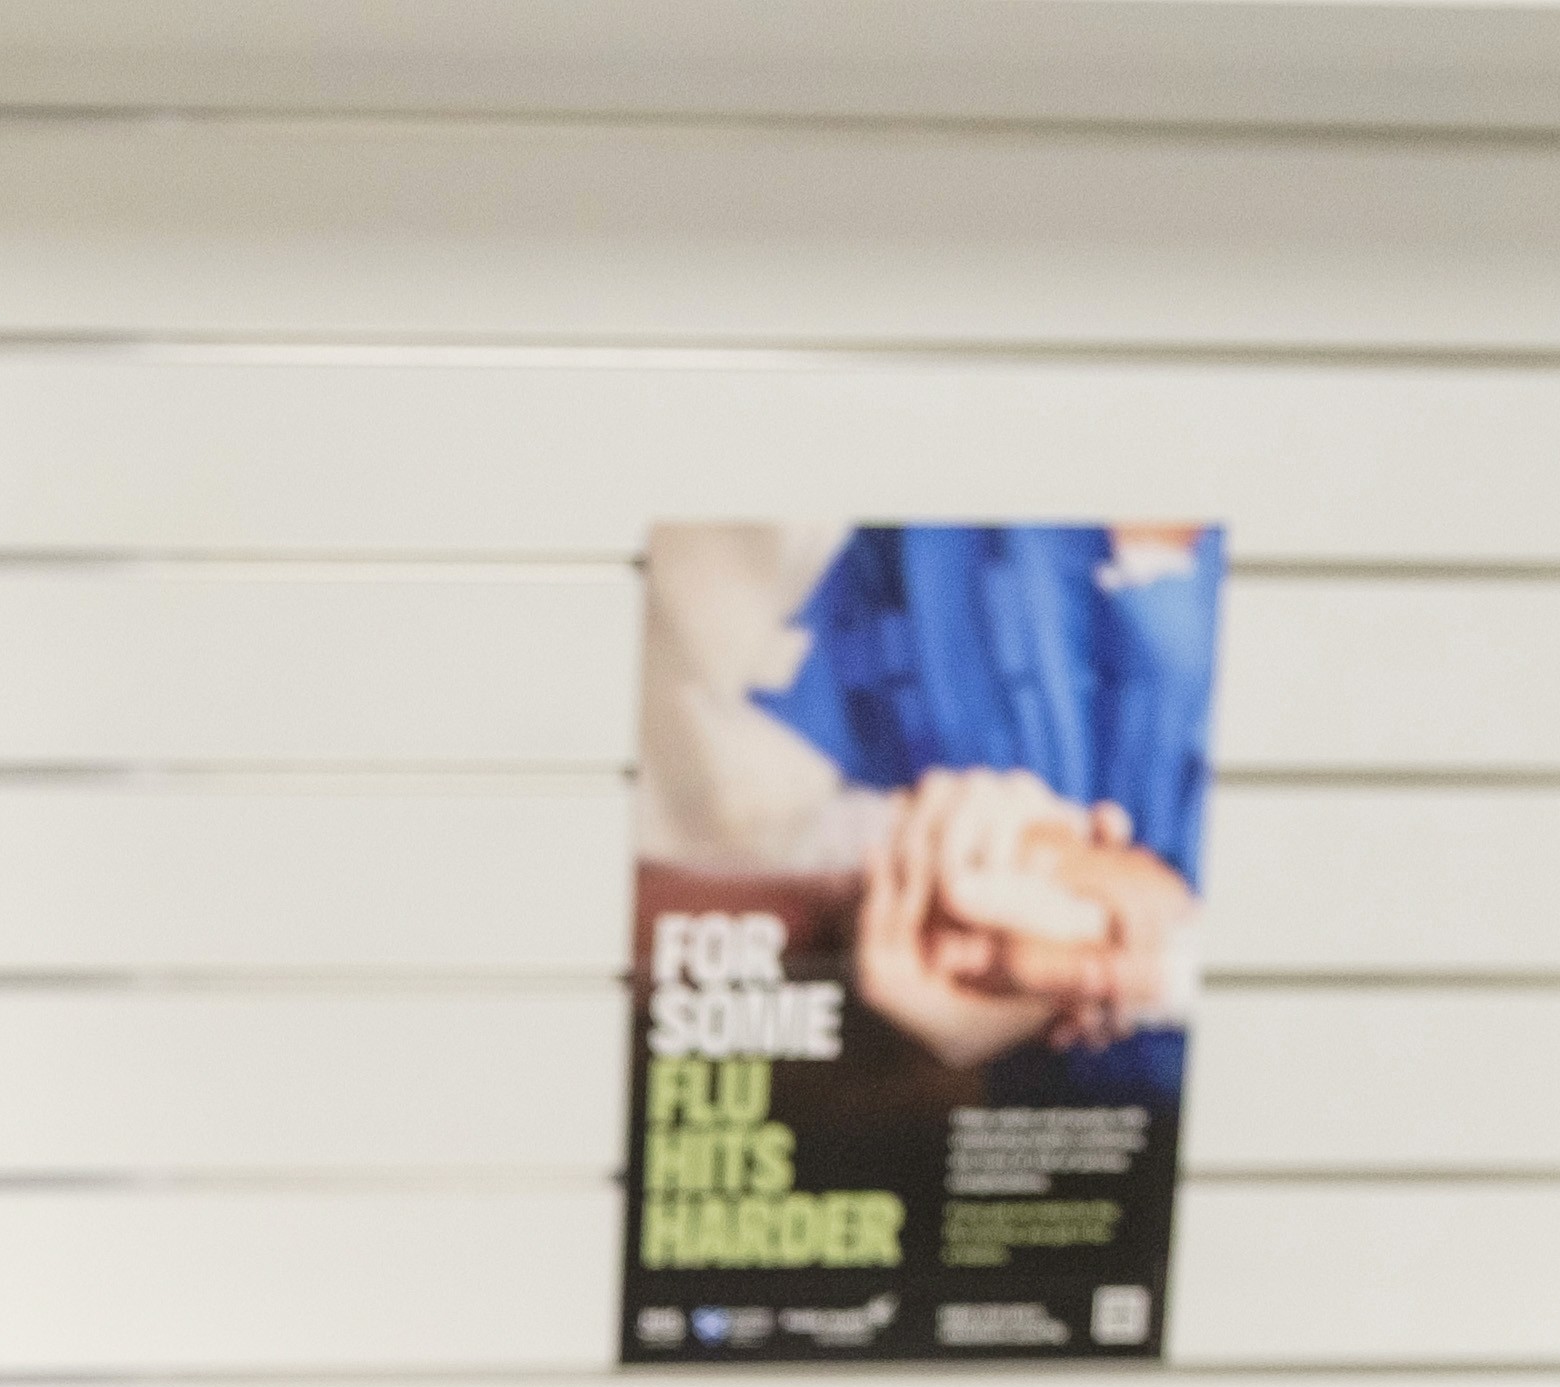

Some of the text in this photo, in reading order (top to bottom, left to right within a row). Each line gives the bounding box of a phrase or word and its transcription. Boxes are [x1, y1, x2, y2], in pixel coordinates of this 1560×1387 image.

[653, 913, 786, 984] FOR
[648, 983, 843, 1060] SOME
[647, 1057, 772, 1124] FLU
[643, 1124, 795, 1194] HITS
[640, 1192, 905, 1268] HARDER
